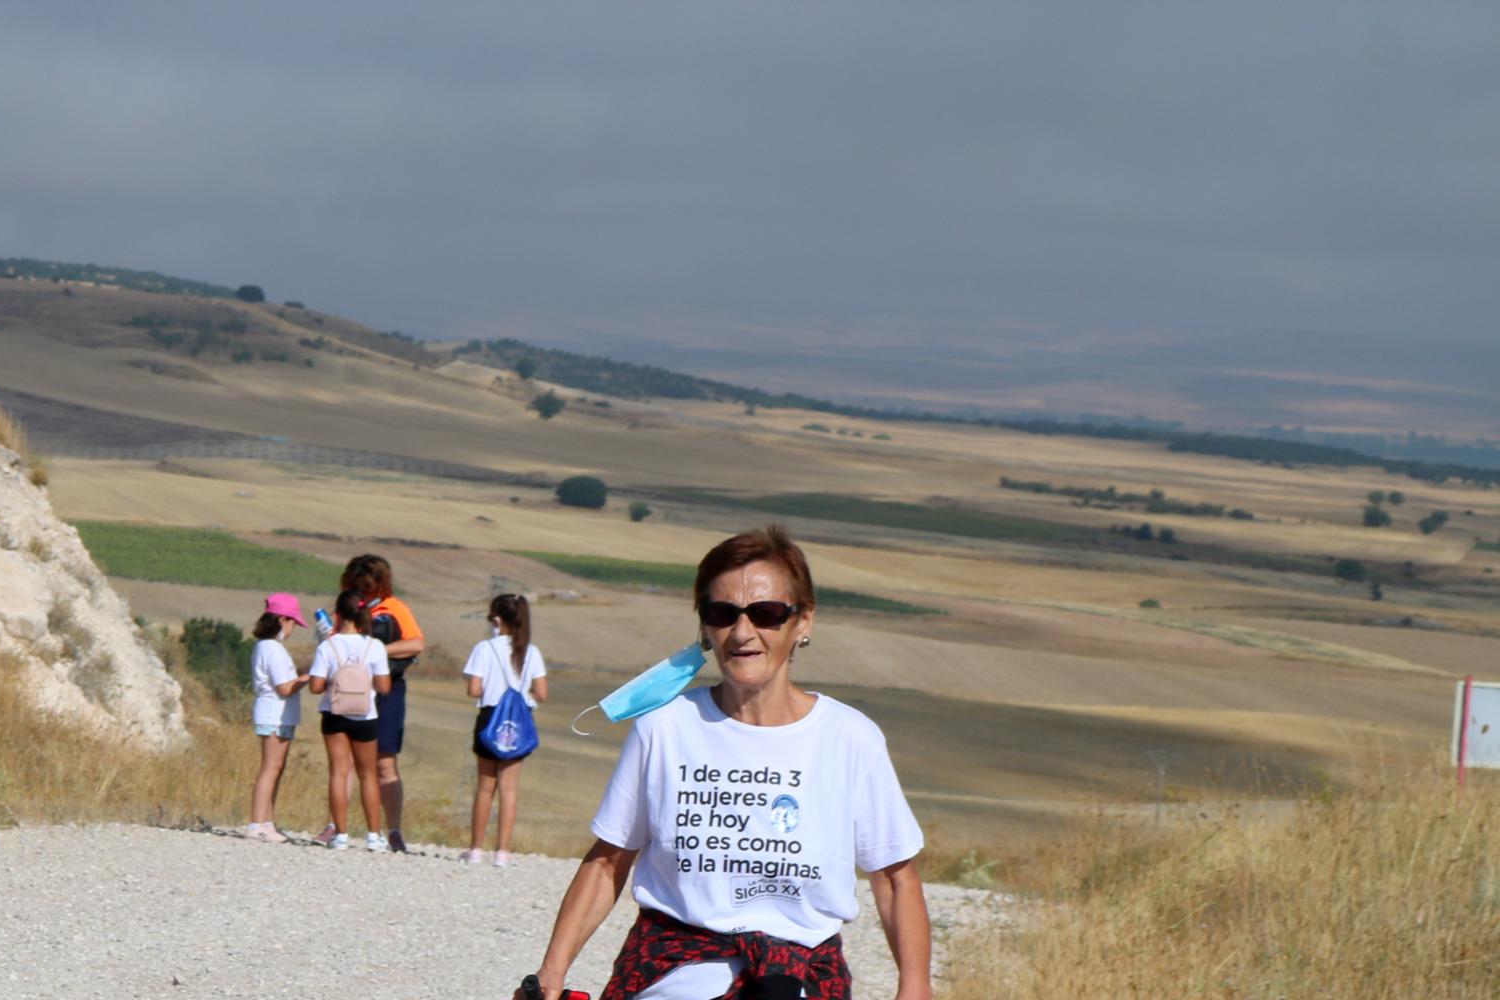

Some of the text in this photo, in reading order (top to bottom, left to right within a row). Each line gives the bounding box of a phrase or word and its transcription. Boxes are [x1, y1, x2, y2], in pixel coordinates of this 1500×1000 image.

[679, 764, 802, 788] 1 de cada 3
[677, 786, 768, 809] mujeres
[676, 809, 750, 833] de hoy
[675, 834, 802, 854] no es como
[698, 854, 716, 873] la
[722, 855, 822, 881] imaginas.
[734, 884, 777, 900] SIGLO
